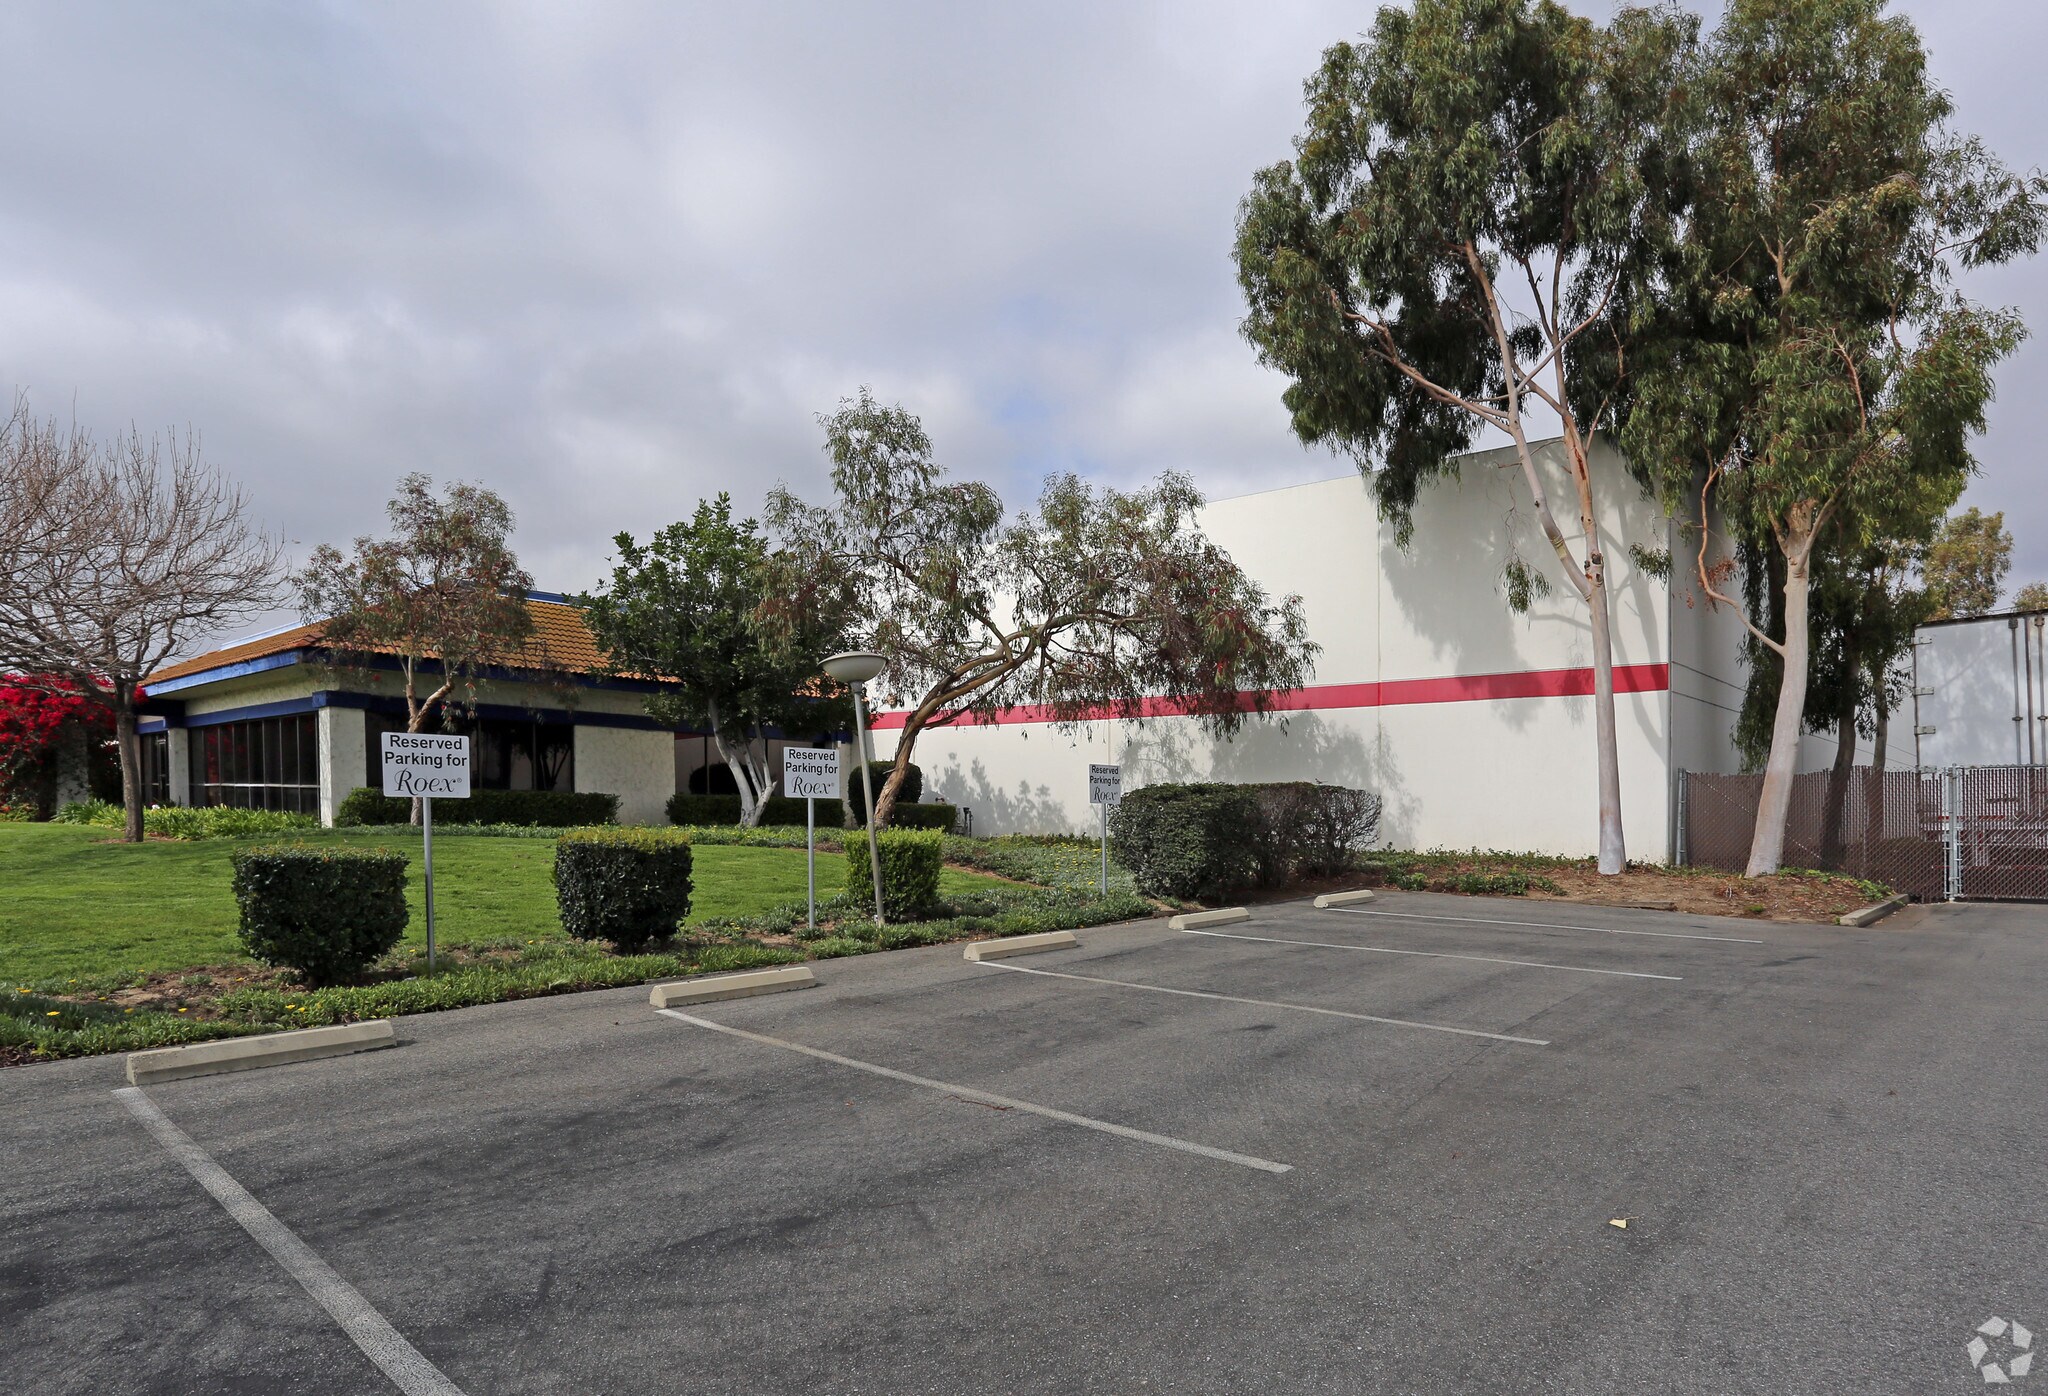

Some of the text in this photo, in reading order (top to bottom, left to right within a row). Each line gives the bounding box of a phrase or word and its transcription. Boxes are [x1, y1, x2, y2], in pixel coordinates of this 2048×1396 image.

[390, 735, 462, 750] Reserved
[385, 751, 467, 769] Parking for
[788, 749, 835, 761] Reserved
[785, 762, 838, 776] Parking for
[1091, 765, 1118, 774] Reserved
[1090, 775, 1120, 786] Parking for
